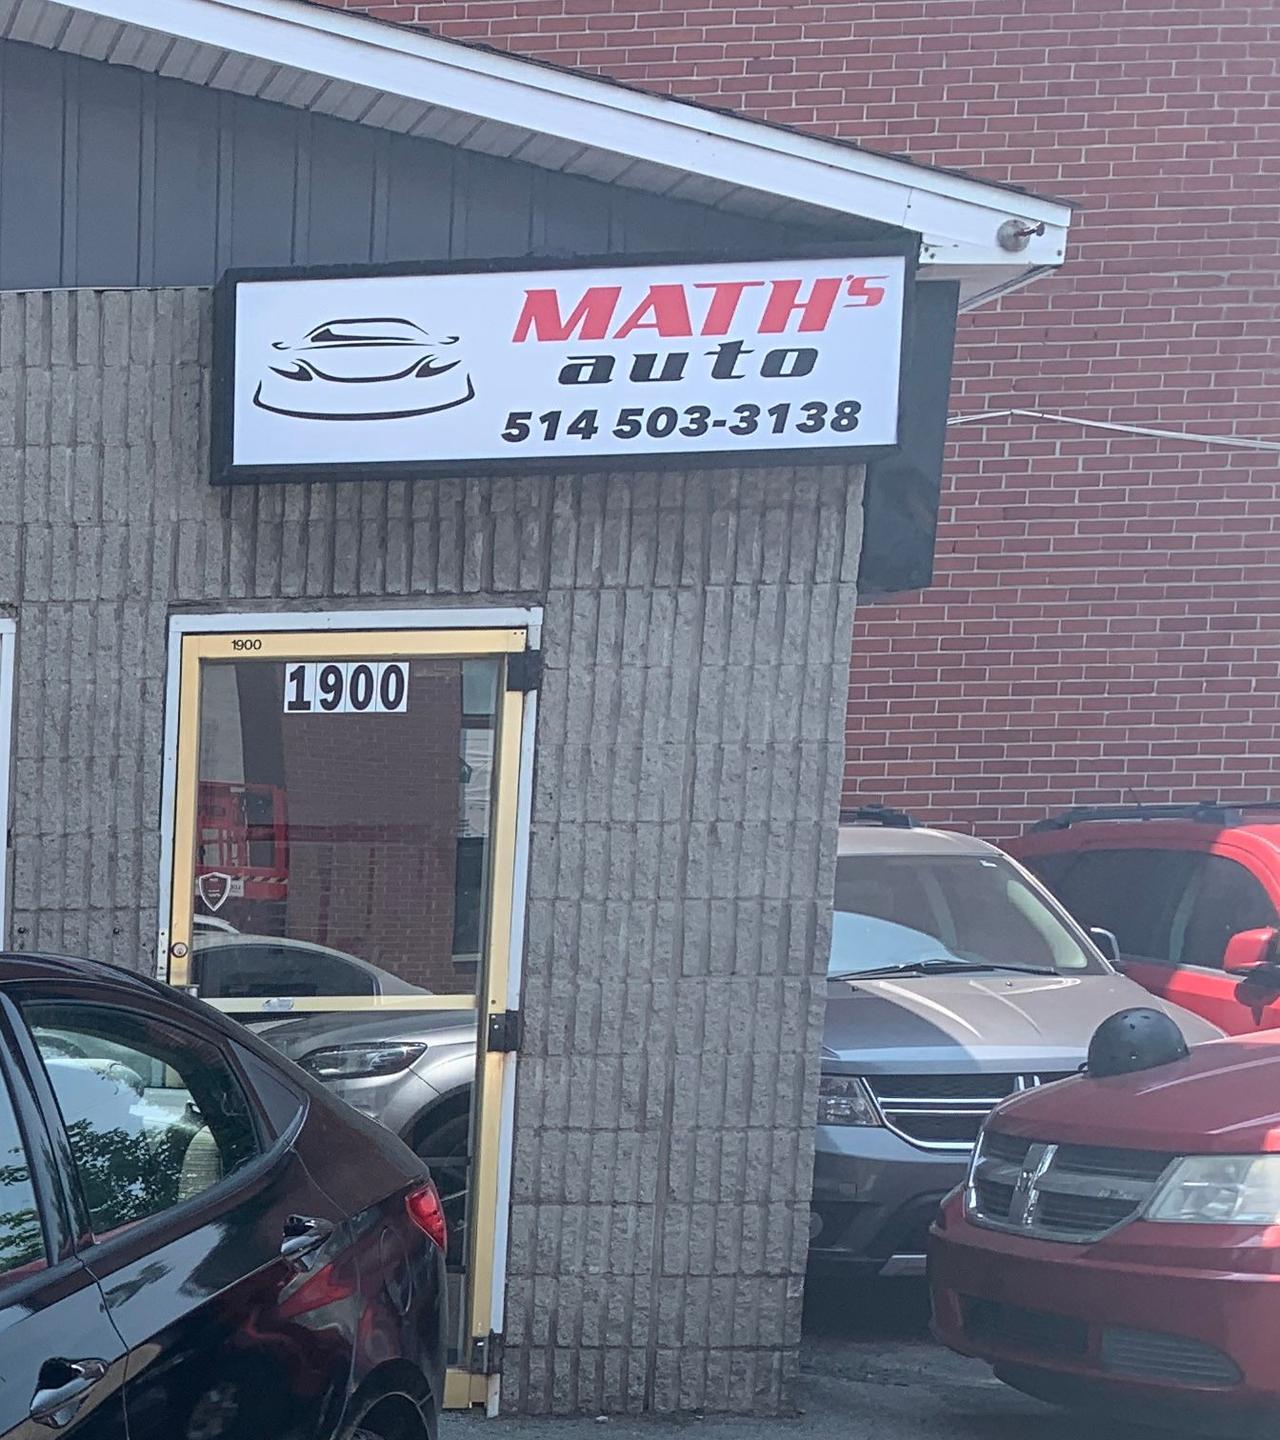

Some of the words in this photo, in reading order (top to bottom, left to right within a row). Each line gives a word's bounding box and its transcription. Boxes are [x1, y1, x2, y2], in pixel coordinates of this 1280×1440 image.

[557, 339, 819, 386] auto
[500, 409, 599, 443] 514
[612, 400, 862, 440] 503-3138
[231, 639, 262, 651] 1900
[287, 664, 405, 711] 1900
